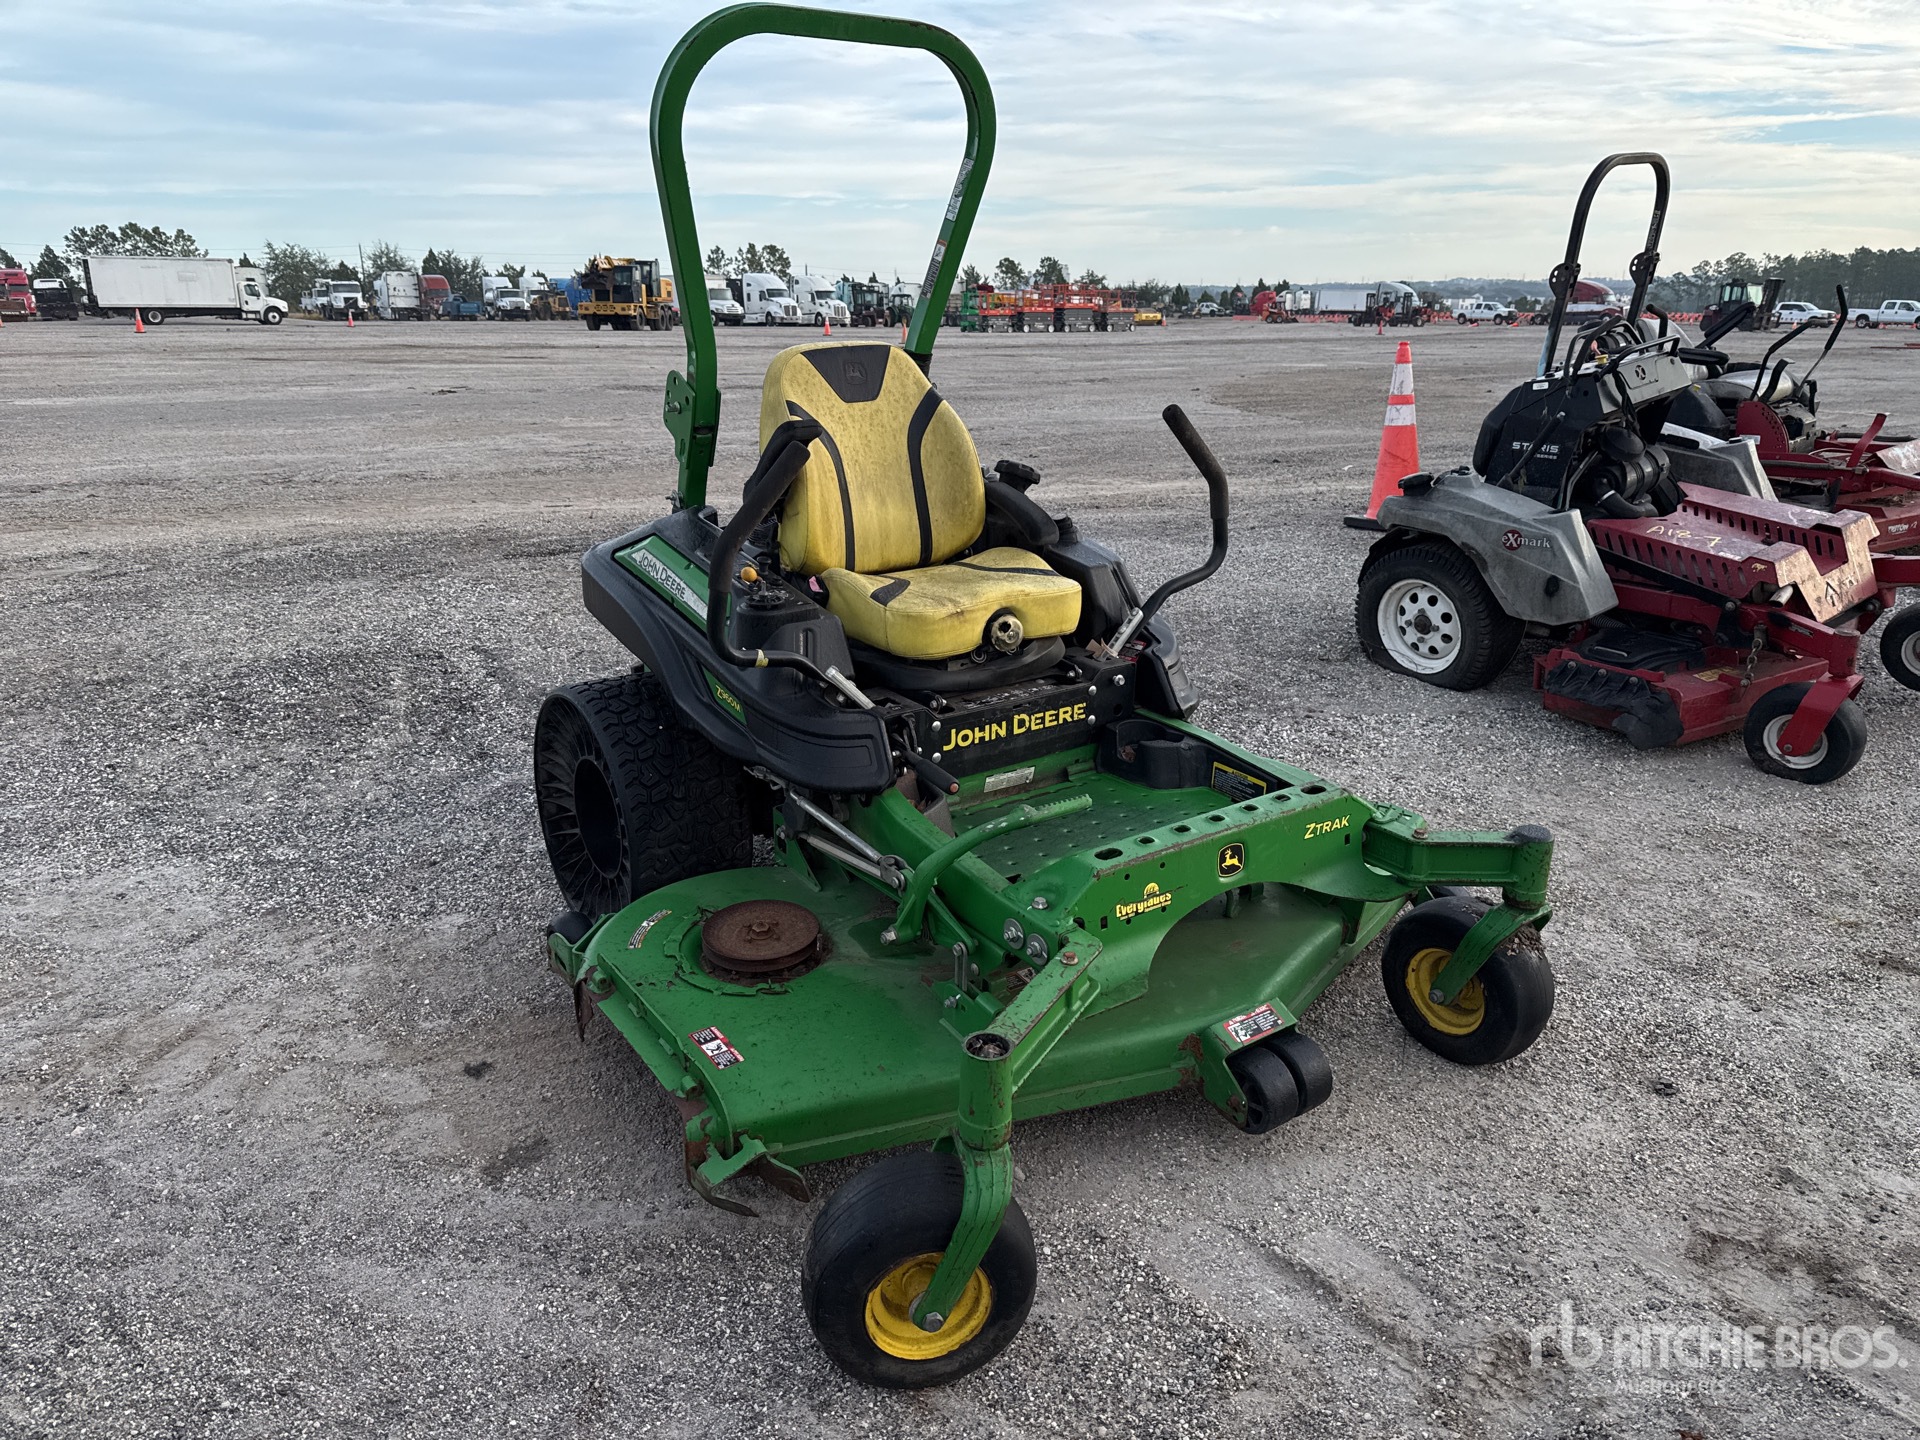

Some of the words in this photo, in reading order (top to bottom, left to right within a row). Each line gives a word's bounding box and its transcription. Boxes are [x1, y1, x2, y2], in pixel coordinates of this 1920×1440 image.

[638, 552, 661, 582] JOHN
[660, 566, 686, 600] DEERE
[943, 721, 1007, 751] JOHN
[1013, 702, 1087, 735] DEERE
[1304, 814, 1351, 840] ZTRAK
